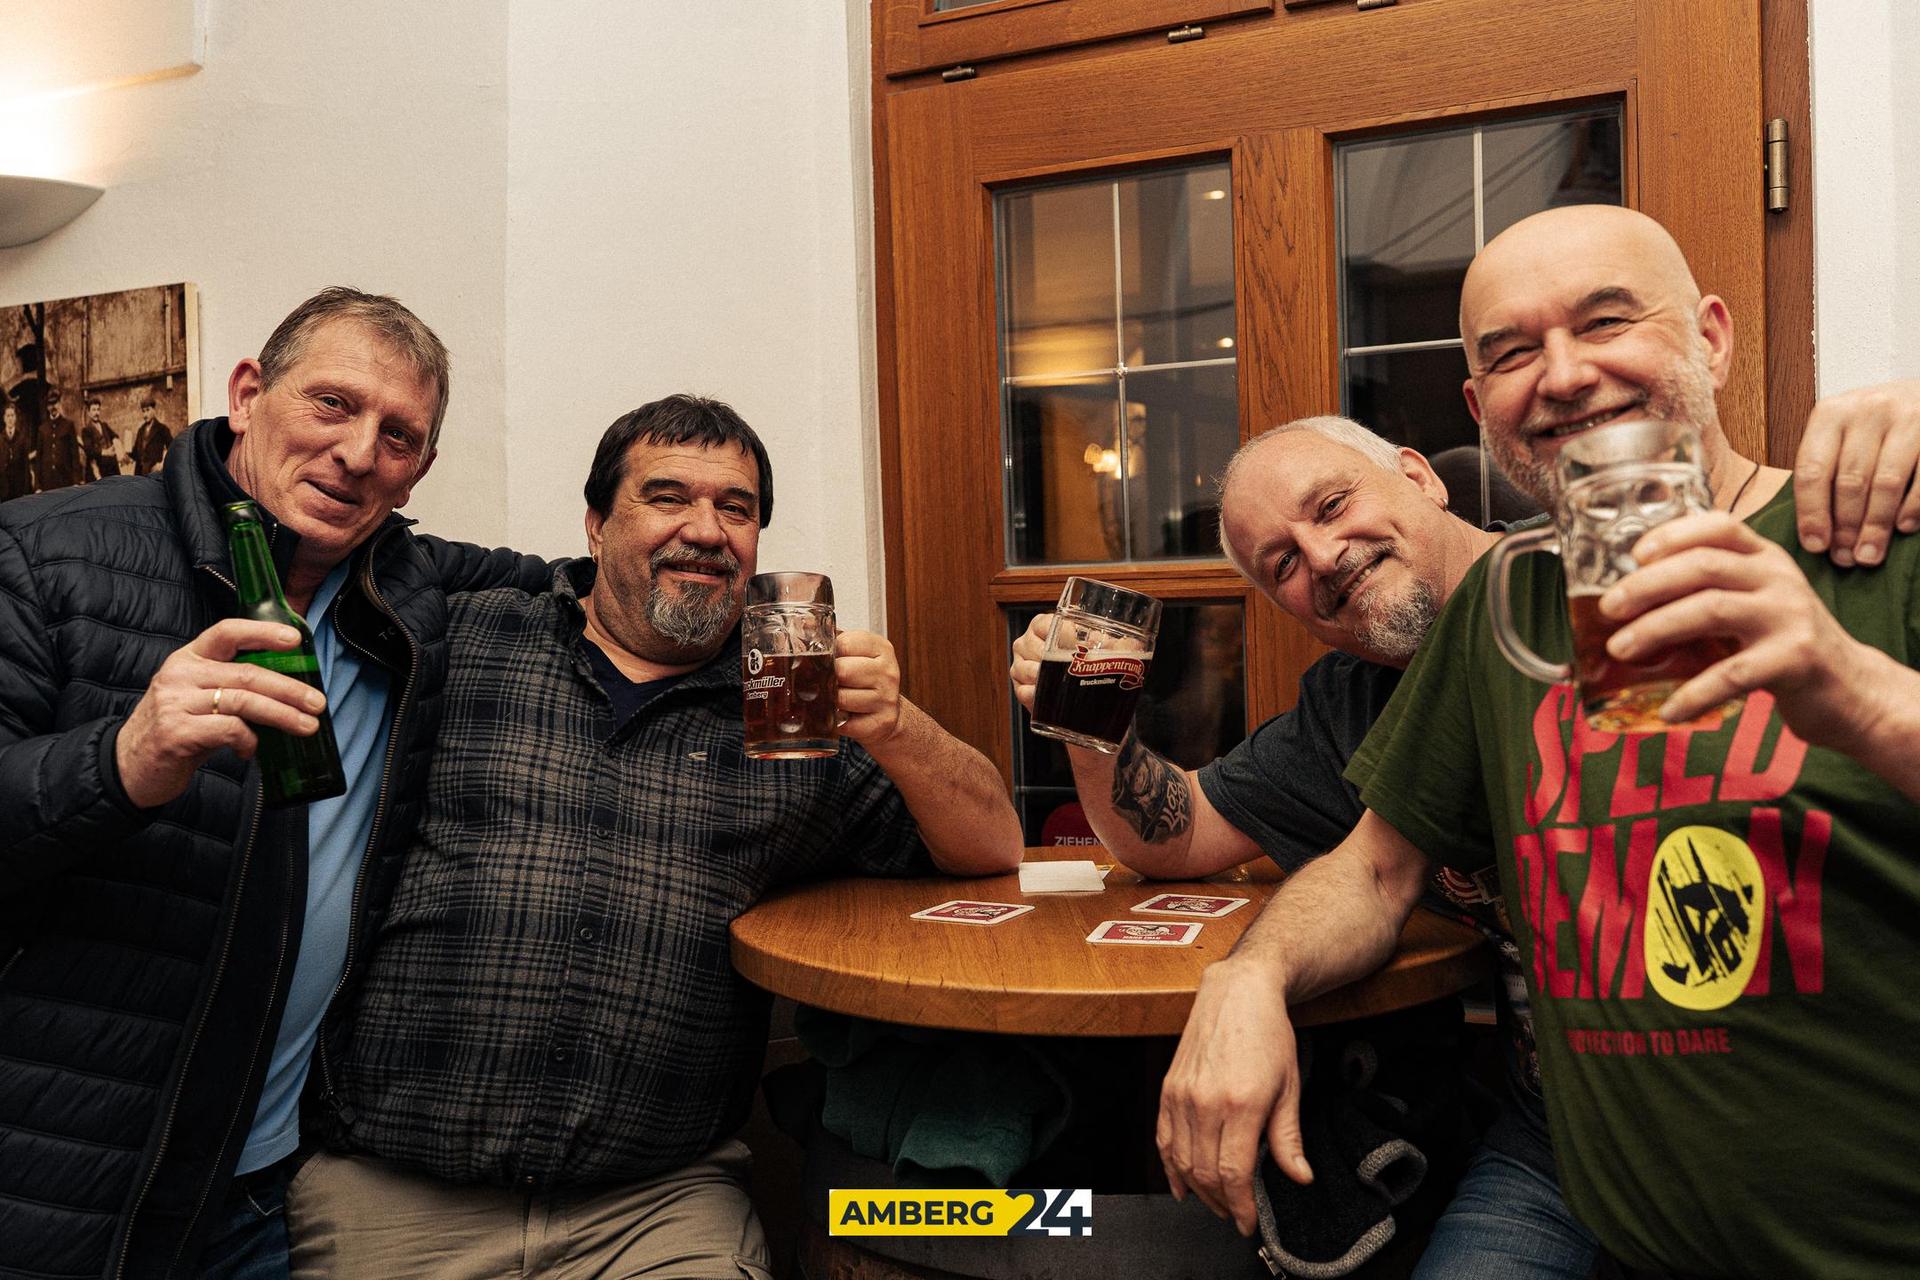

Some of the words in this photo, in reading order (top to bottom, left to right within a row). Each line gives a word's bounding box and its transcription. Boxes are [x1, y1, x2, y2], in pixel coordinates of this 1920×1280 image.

[743, 676, 785, 691] ckmüller
[1524, 683, 1809, 828] SPEED
[1514, 807, 1832, 1010] DEMON
[1649, 1030, 1674, 1056] TO
[1676, 1027, 1734, 1056] DARE
